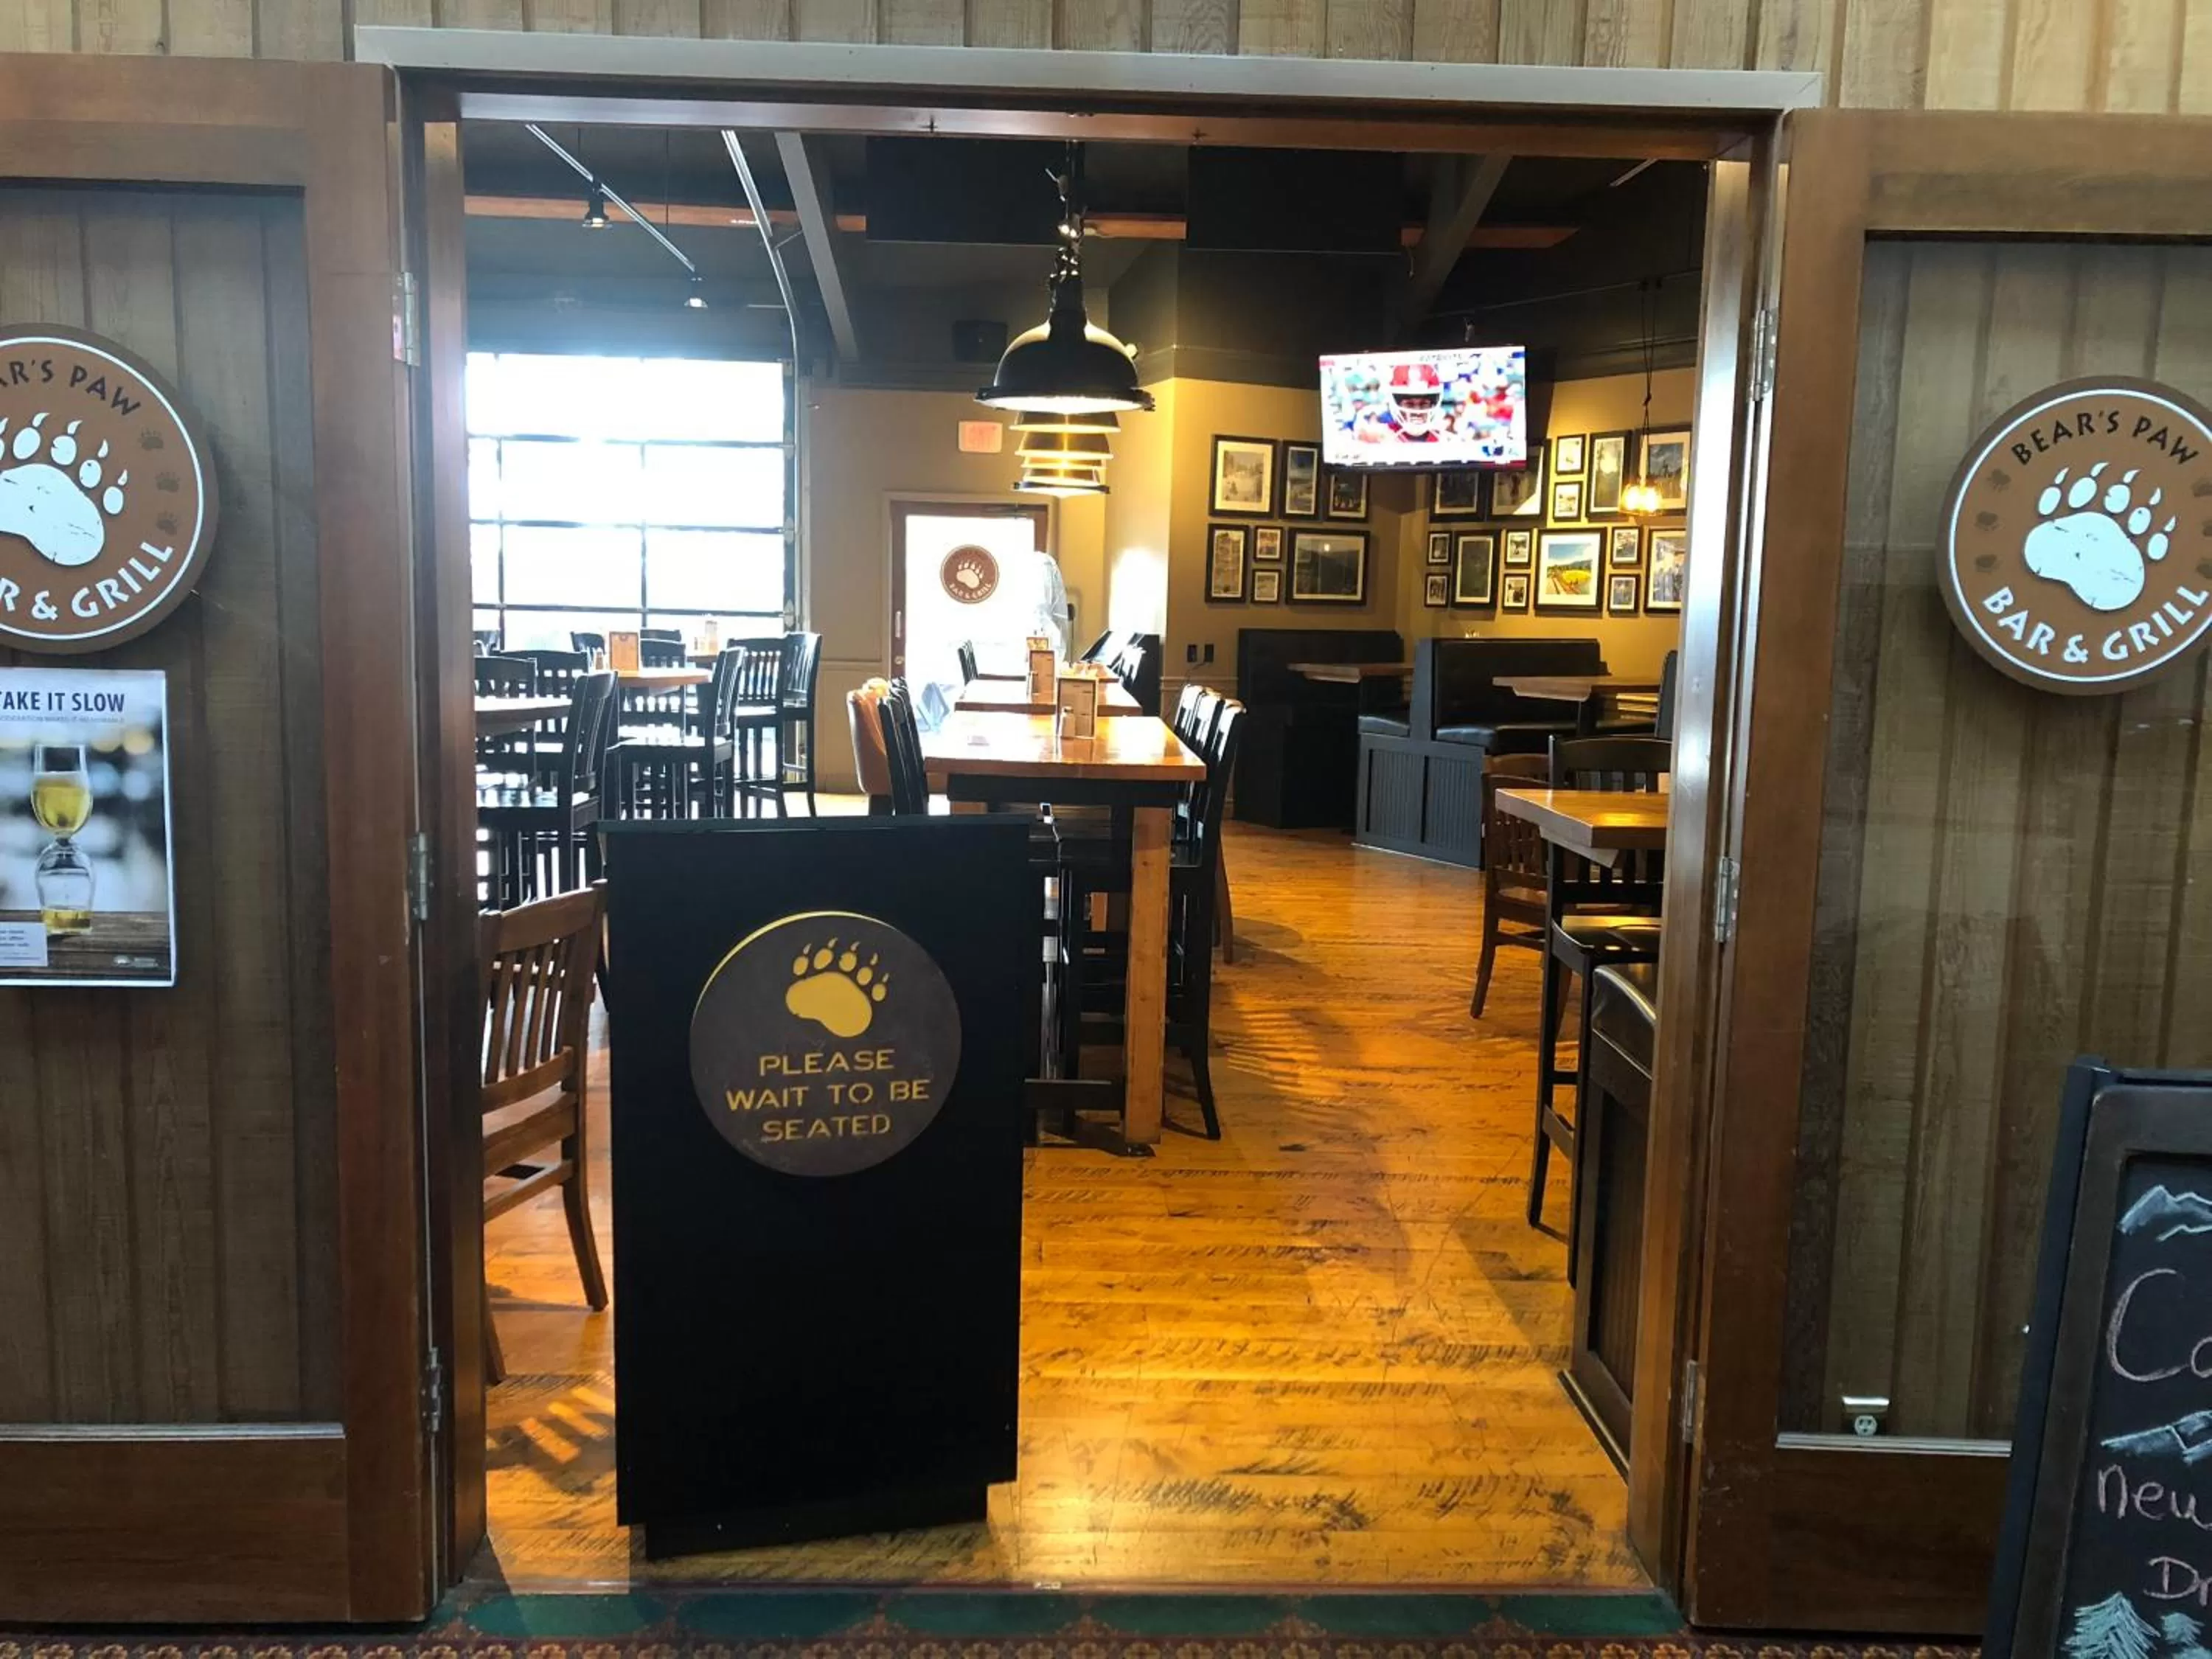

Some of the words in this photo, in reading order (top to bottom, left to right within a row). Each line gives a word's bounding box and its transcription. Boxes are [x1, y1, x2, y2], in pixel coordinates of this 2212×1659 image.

[69, 365, 141, 415] PAW
[2011, 410, 2120, 465] BEAR'S
[2132, 416, 2199, 465] PAW
[31, 590, 58, 621] &
[72, 542, 173, 617] GRILL
[1983, 586, 2056, 655] BAR
[2062, 634, 2088, 663] &
[2101, 585, 2209, 661] GRILL
[0, 691, 41, 710] AKE
[48, 692, 65, 711] IT
[72, 692, 125, 712] SLOW
[759, 1049, 896, 1077] PLEASE
[726, 1086, 810, 1110] WAIT
[827, 1084, 873, 1105] TO
[889, 1079, 931, 1101] BE
[761, 1114, 891, 1143] SEATED
